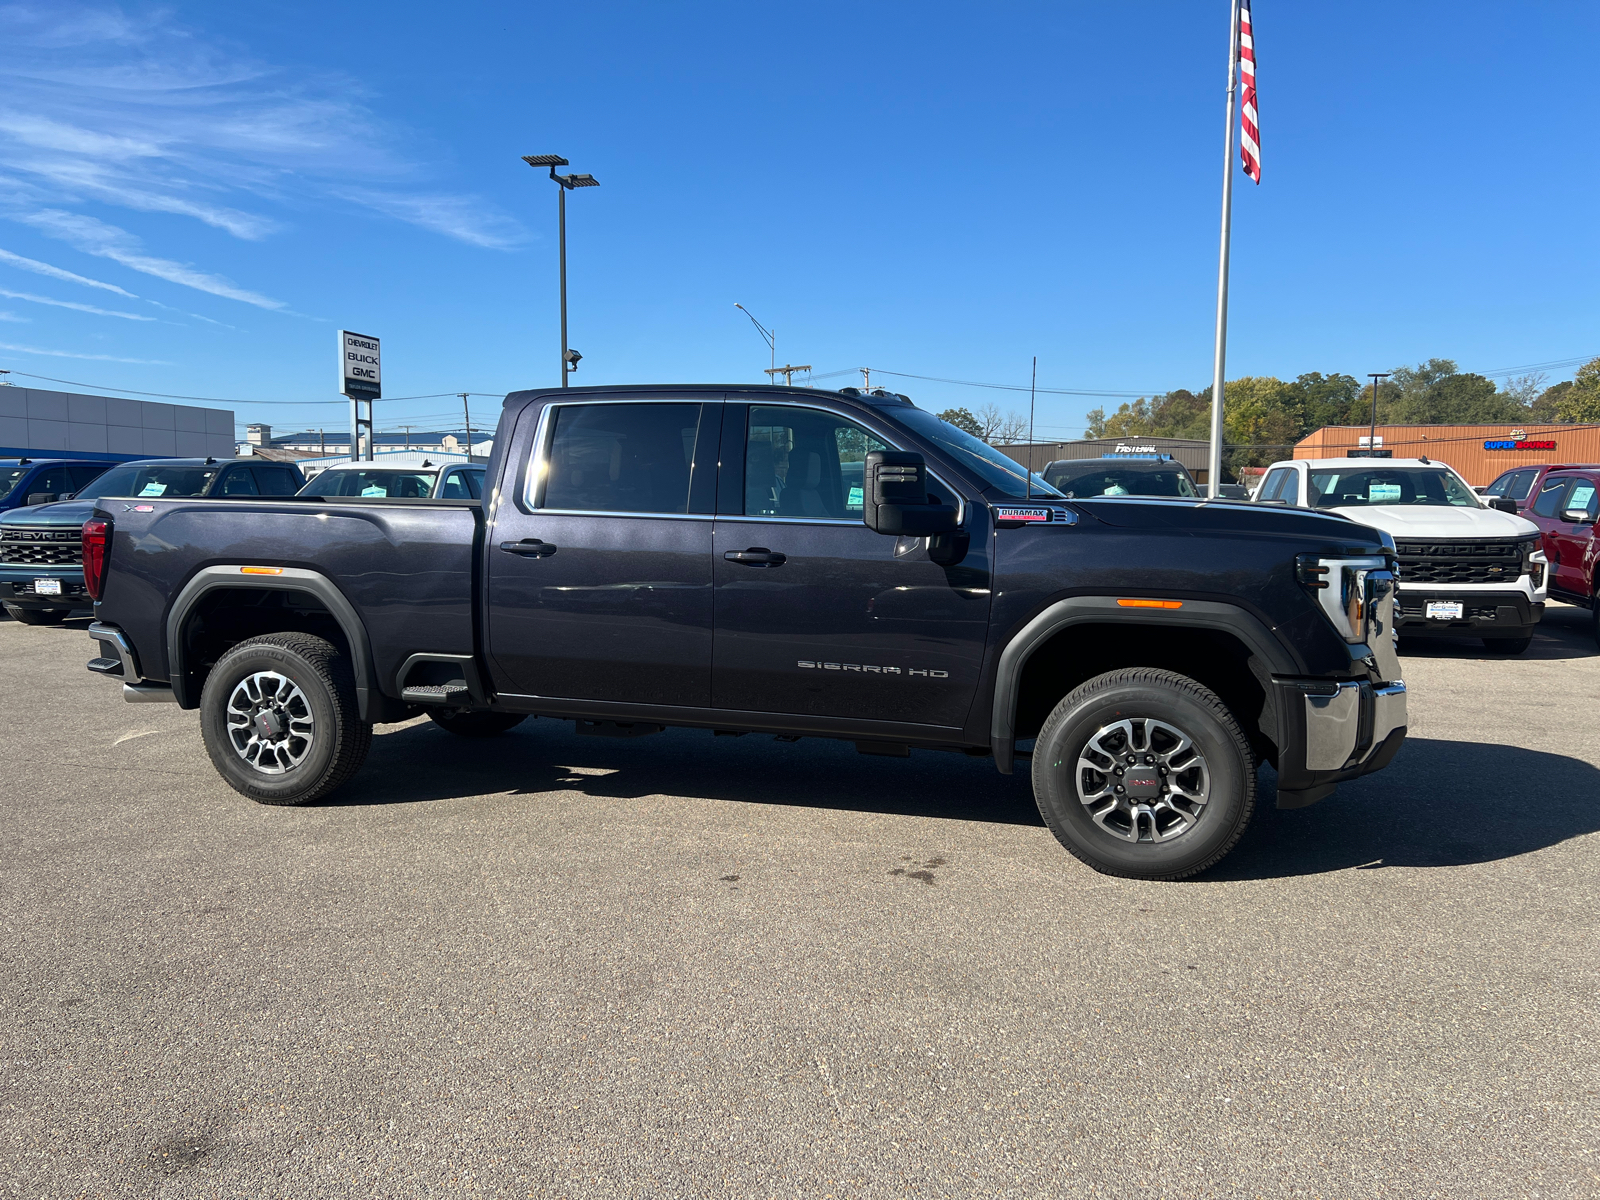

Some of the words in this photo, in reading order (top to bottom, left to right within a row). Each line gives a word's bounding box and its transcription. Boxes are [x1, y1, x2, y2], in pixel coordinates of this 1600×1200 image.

[348, 338, 377, 350] CHEVROLET
[348, 352, 378, 365] BUICK
[353, 367, 375, 378] GMC
[1115, 443, 1157, 453] FASTENAL
[1484, 441, 1515, 449] SUPER
[1516, 441, 1555, 449] BOUNCE
[797, 660, 902, 675] SIERRA
[908, 668, 949, 678] HD
